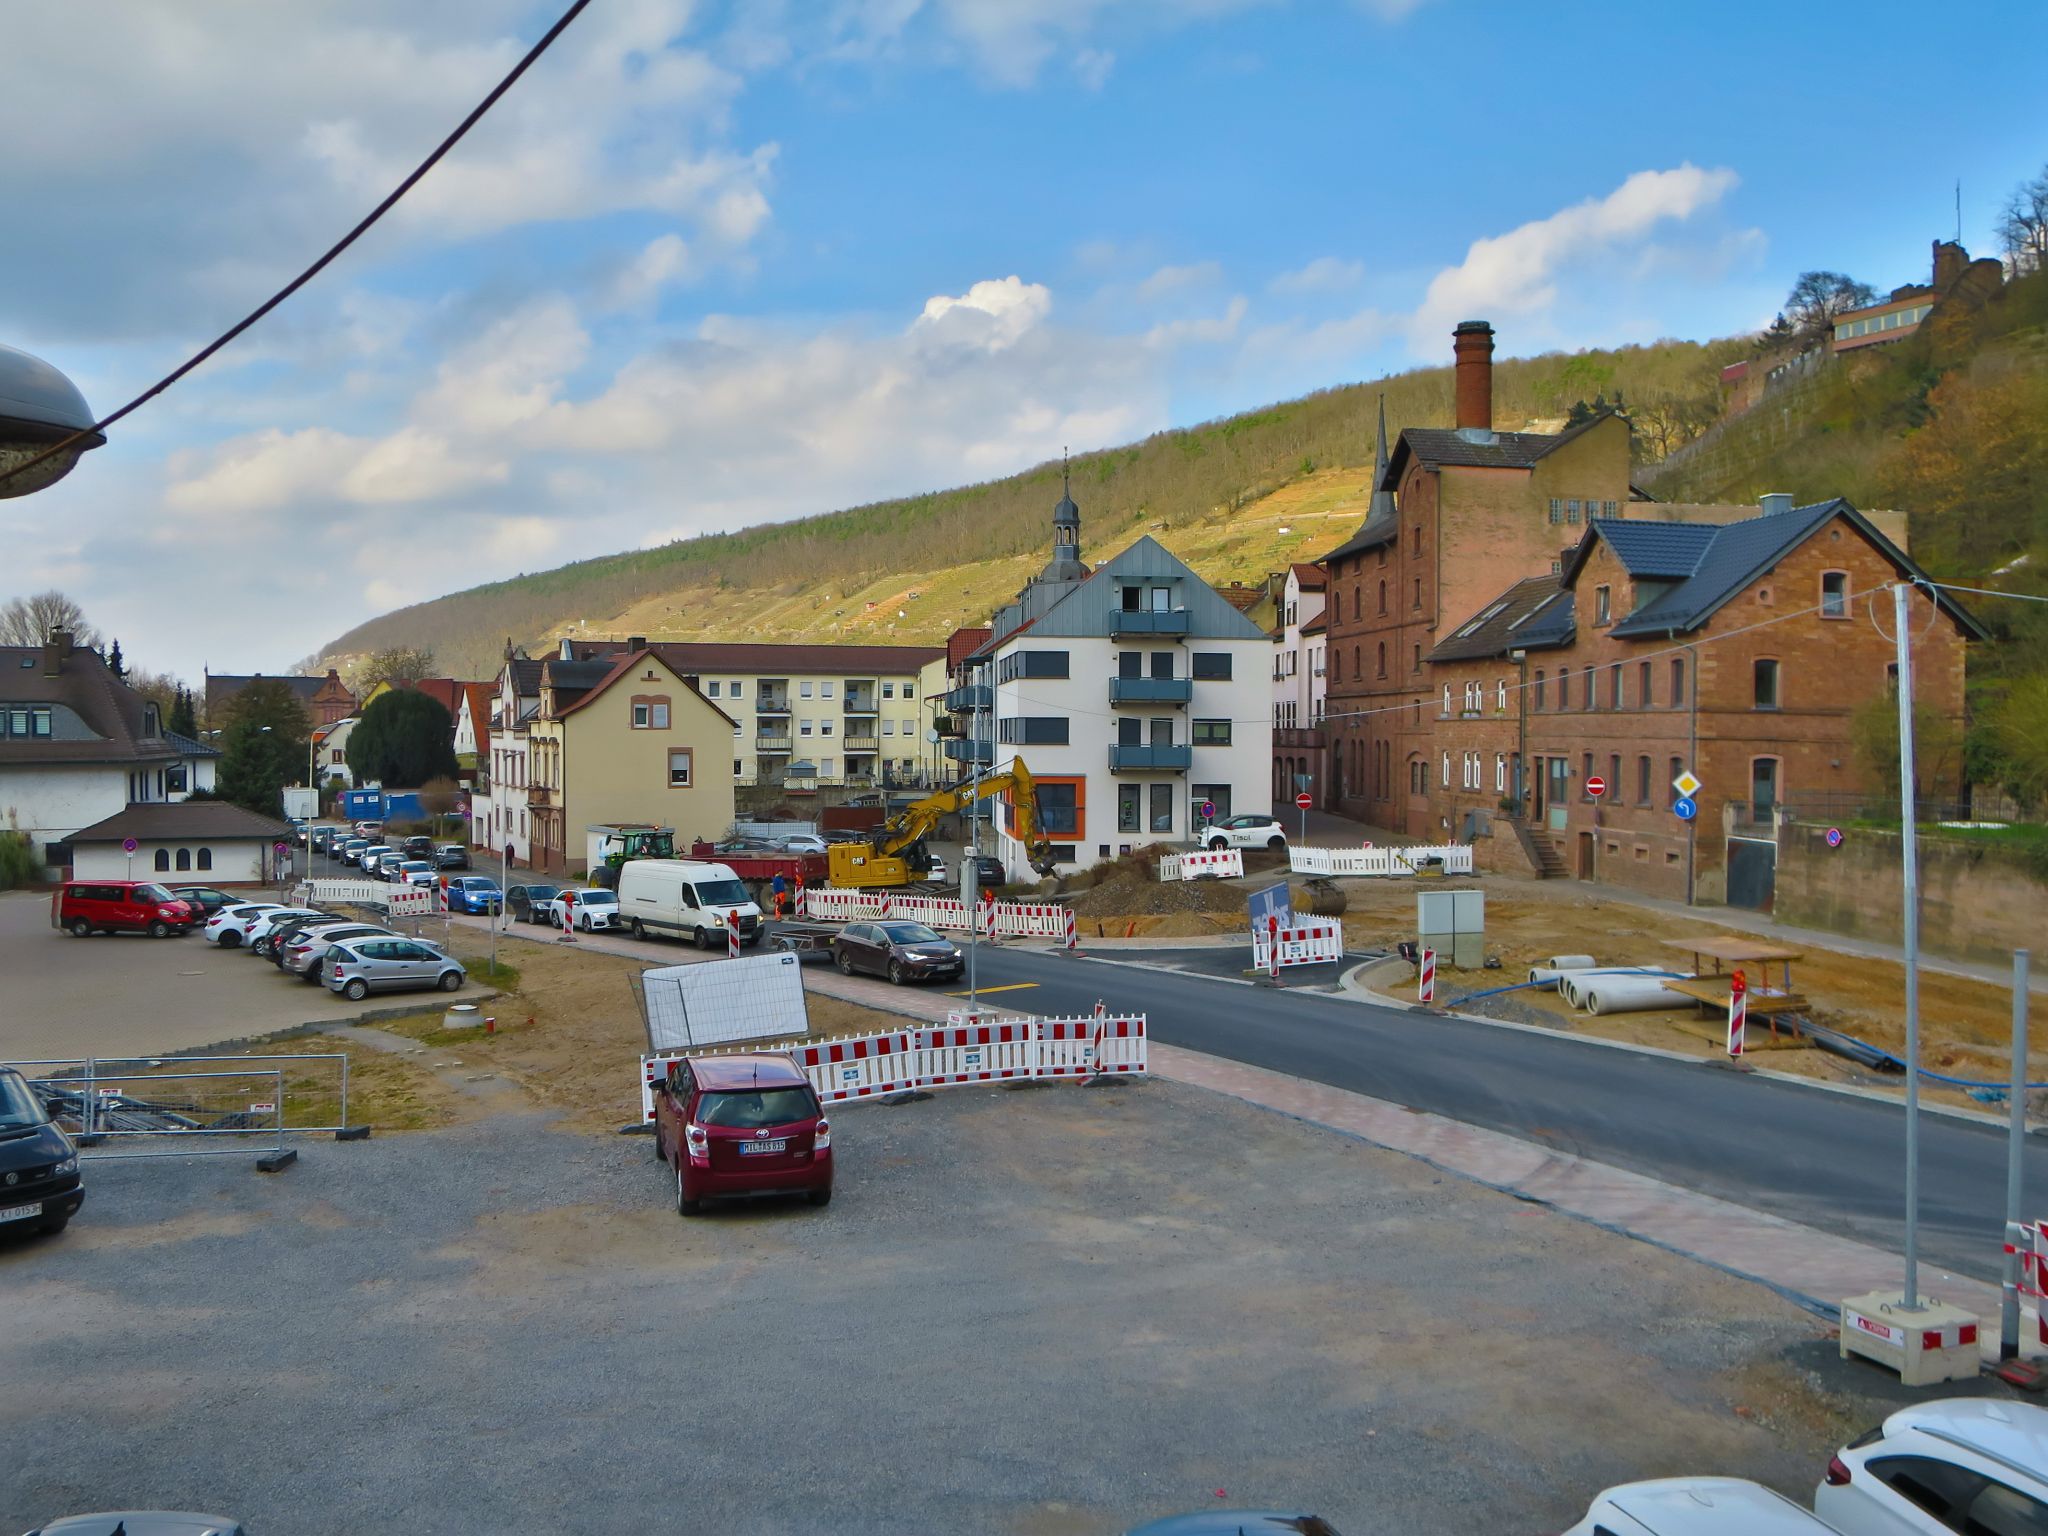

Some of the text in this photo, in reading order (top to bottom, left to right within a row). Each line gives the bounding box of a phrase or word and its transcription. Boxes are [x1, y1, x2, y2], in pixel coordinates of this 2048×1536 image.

[962, 788, 975, 800] CAT
[852, 857, 863, 865] CAT
[745, 1141, 785, 1152] MIL AS 815
